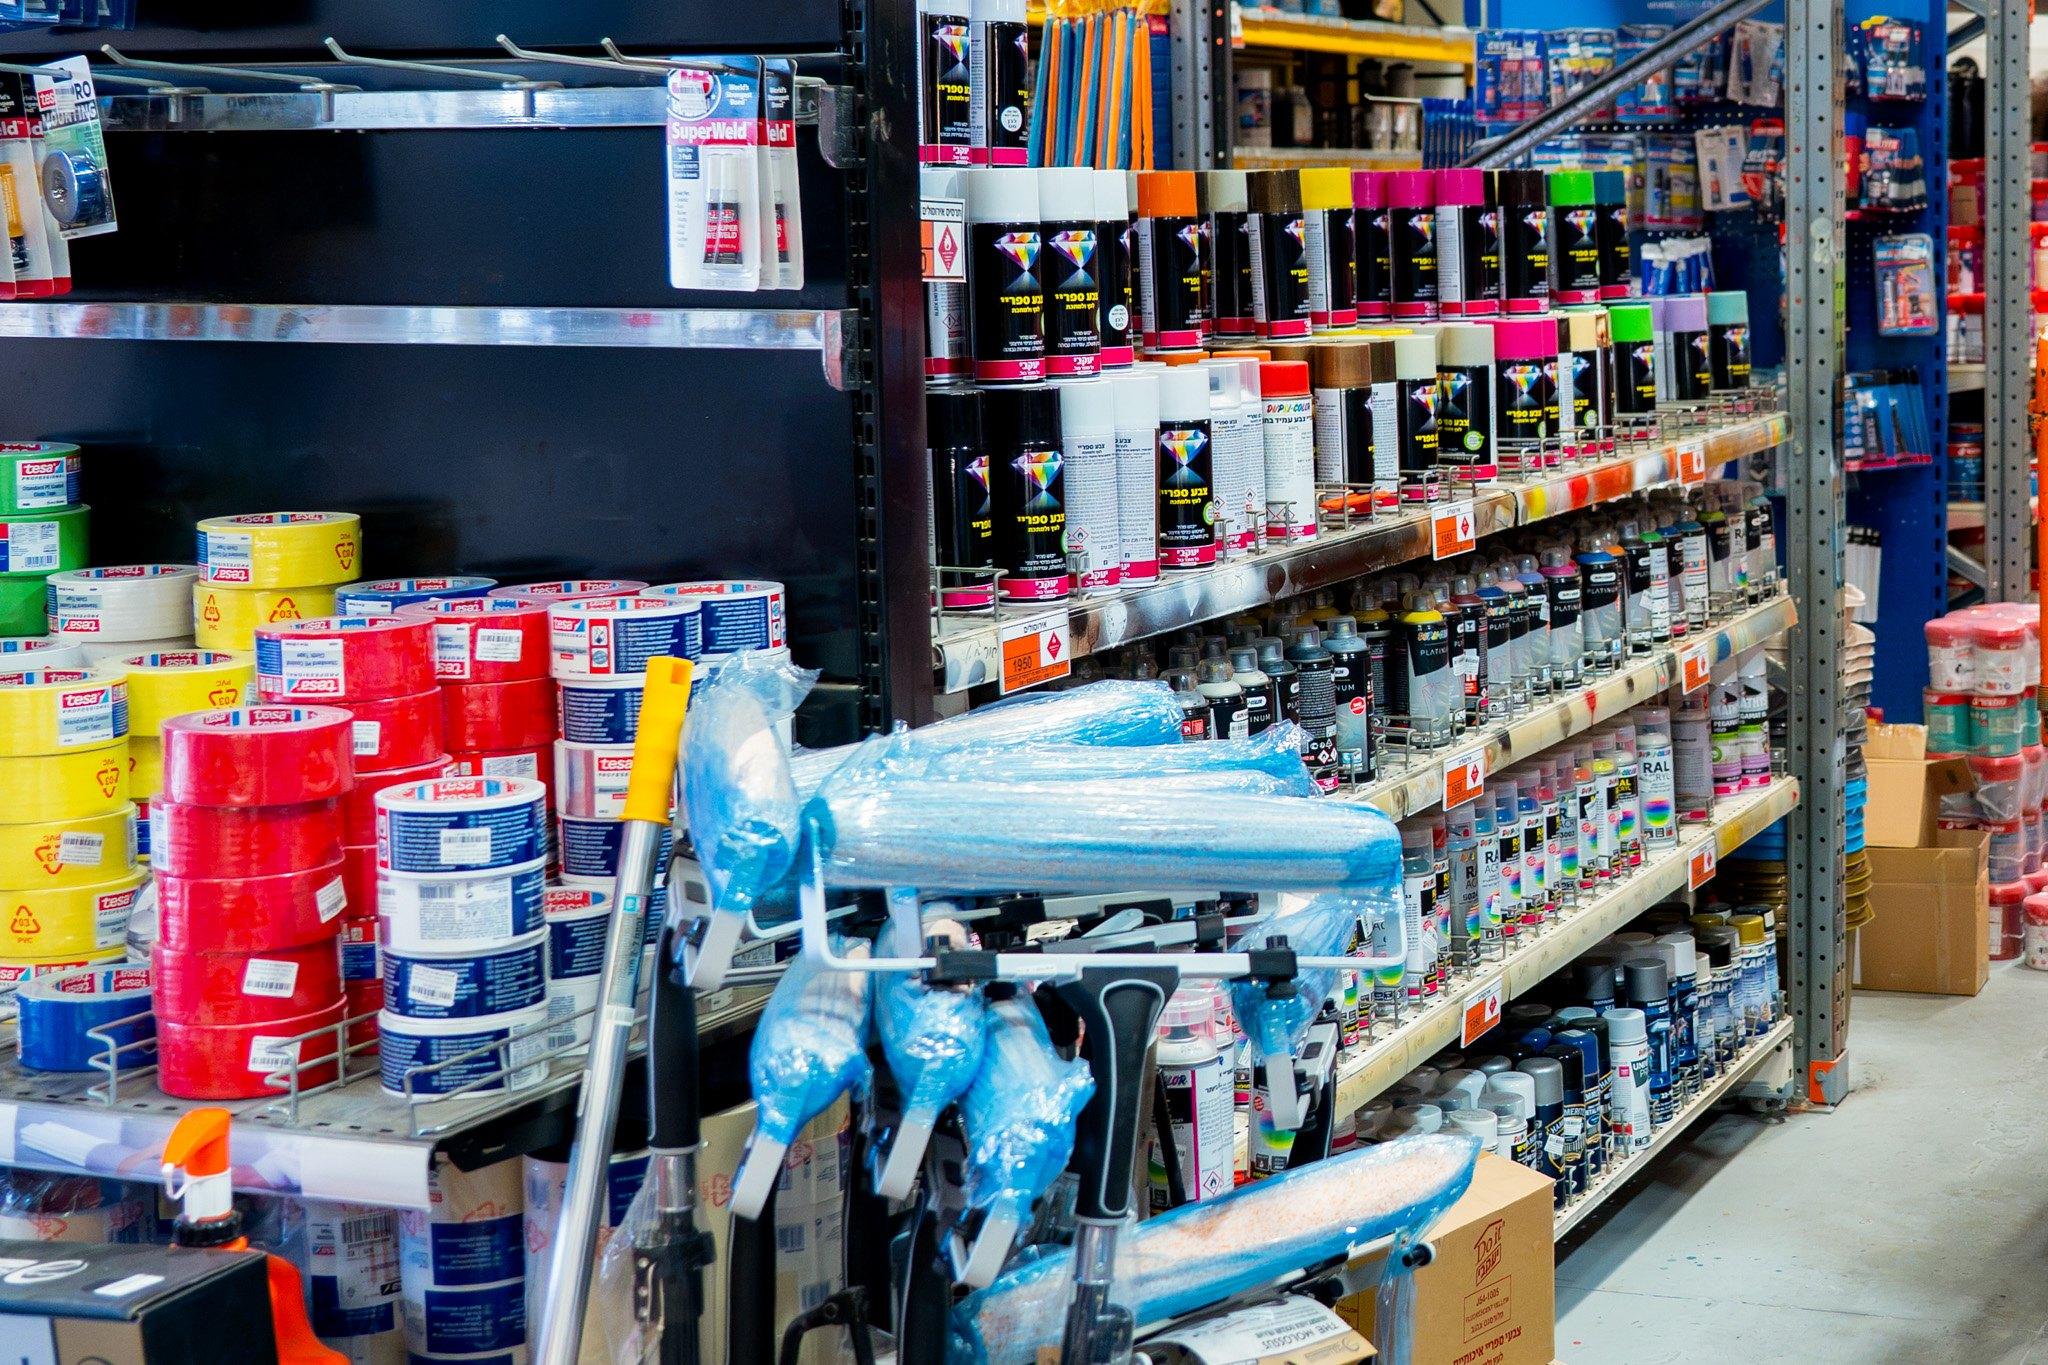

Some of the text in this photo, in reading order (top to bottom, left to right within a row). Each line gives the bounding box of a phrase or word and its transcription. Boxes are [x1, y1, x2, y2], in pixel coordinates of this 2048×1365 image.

[671, 121, 748, 143] SuperWeld
[24, 463, 54, 475] tesa
[1191, 486, 1208, 497] צבע
[1017, 514, 1048, 526] ספריי
[217, 569, 246, 581] tesa
[279, 609, 292, 618] 03
[69, 620, 97, 631] tesa
[553, 618, 575, 630] tesa
[1012, 656, 1033, 673] 1950
[300, 679, 337, 692] tesa
[65, 694, 99, 707] tesa
[598, 757, 633, 771] tesa
[1643, 761, 1670, 774] RAL
[1485, 850, 1500, 864] RA
[101, 894, 132, 908] tesa
[1261, 1329, 1313, 1351] MOLOSSUS
